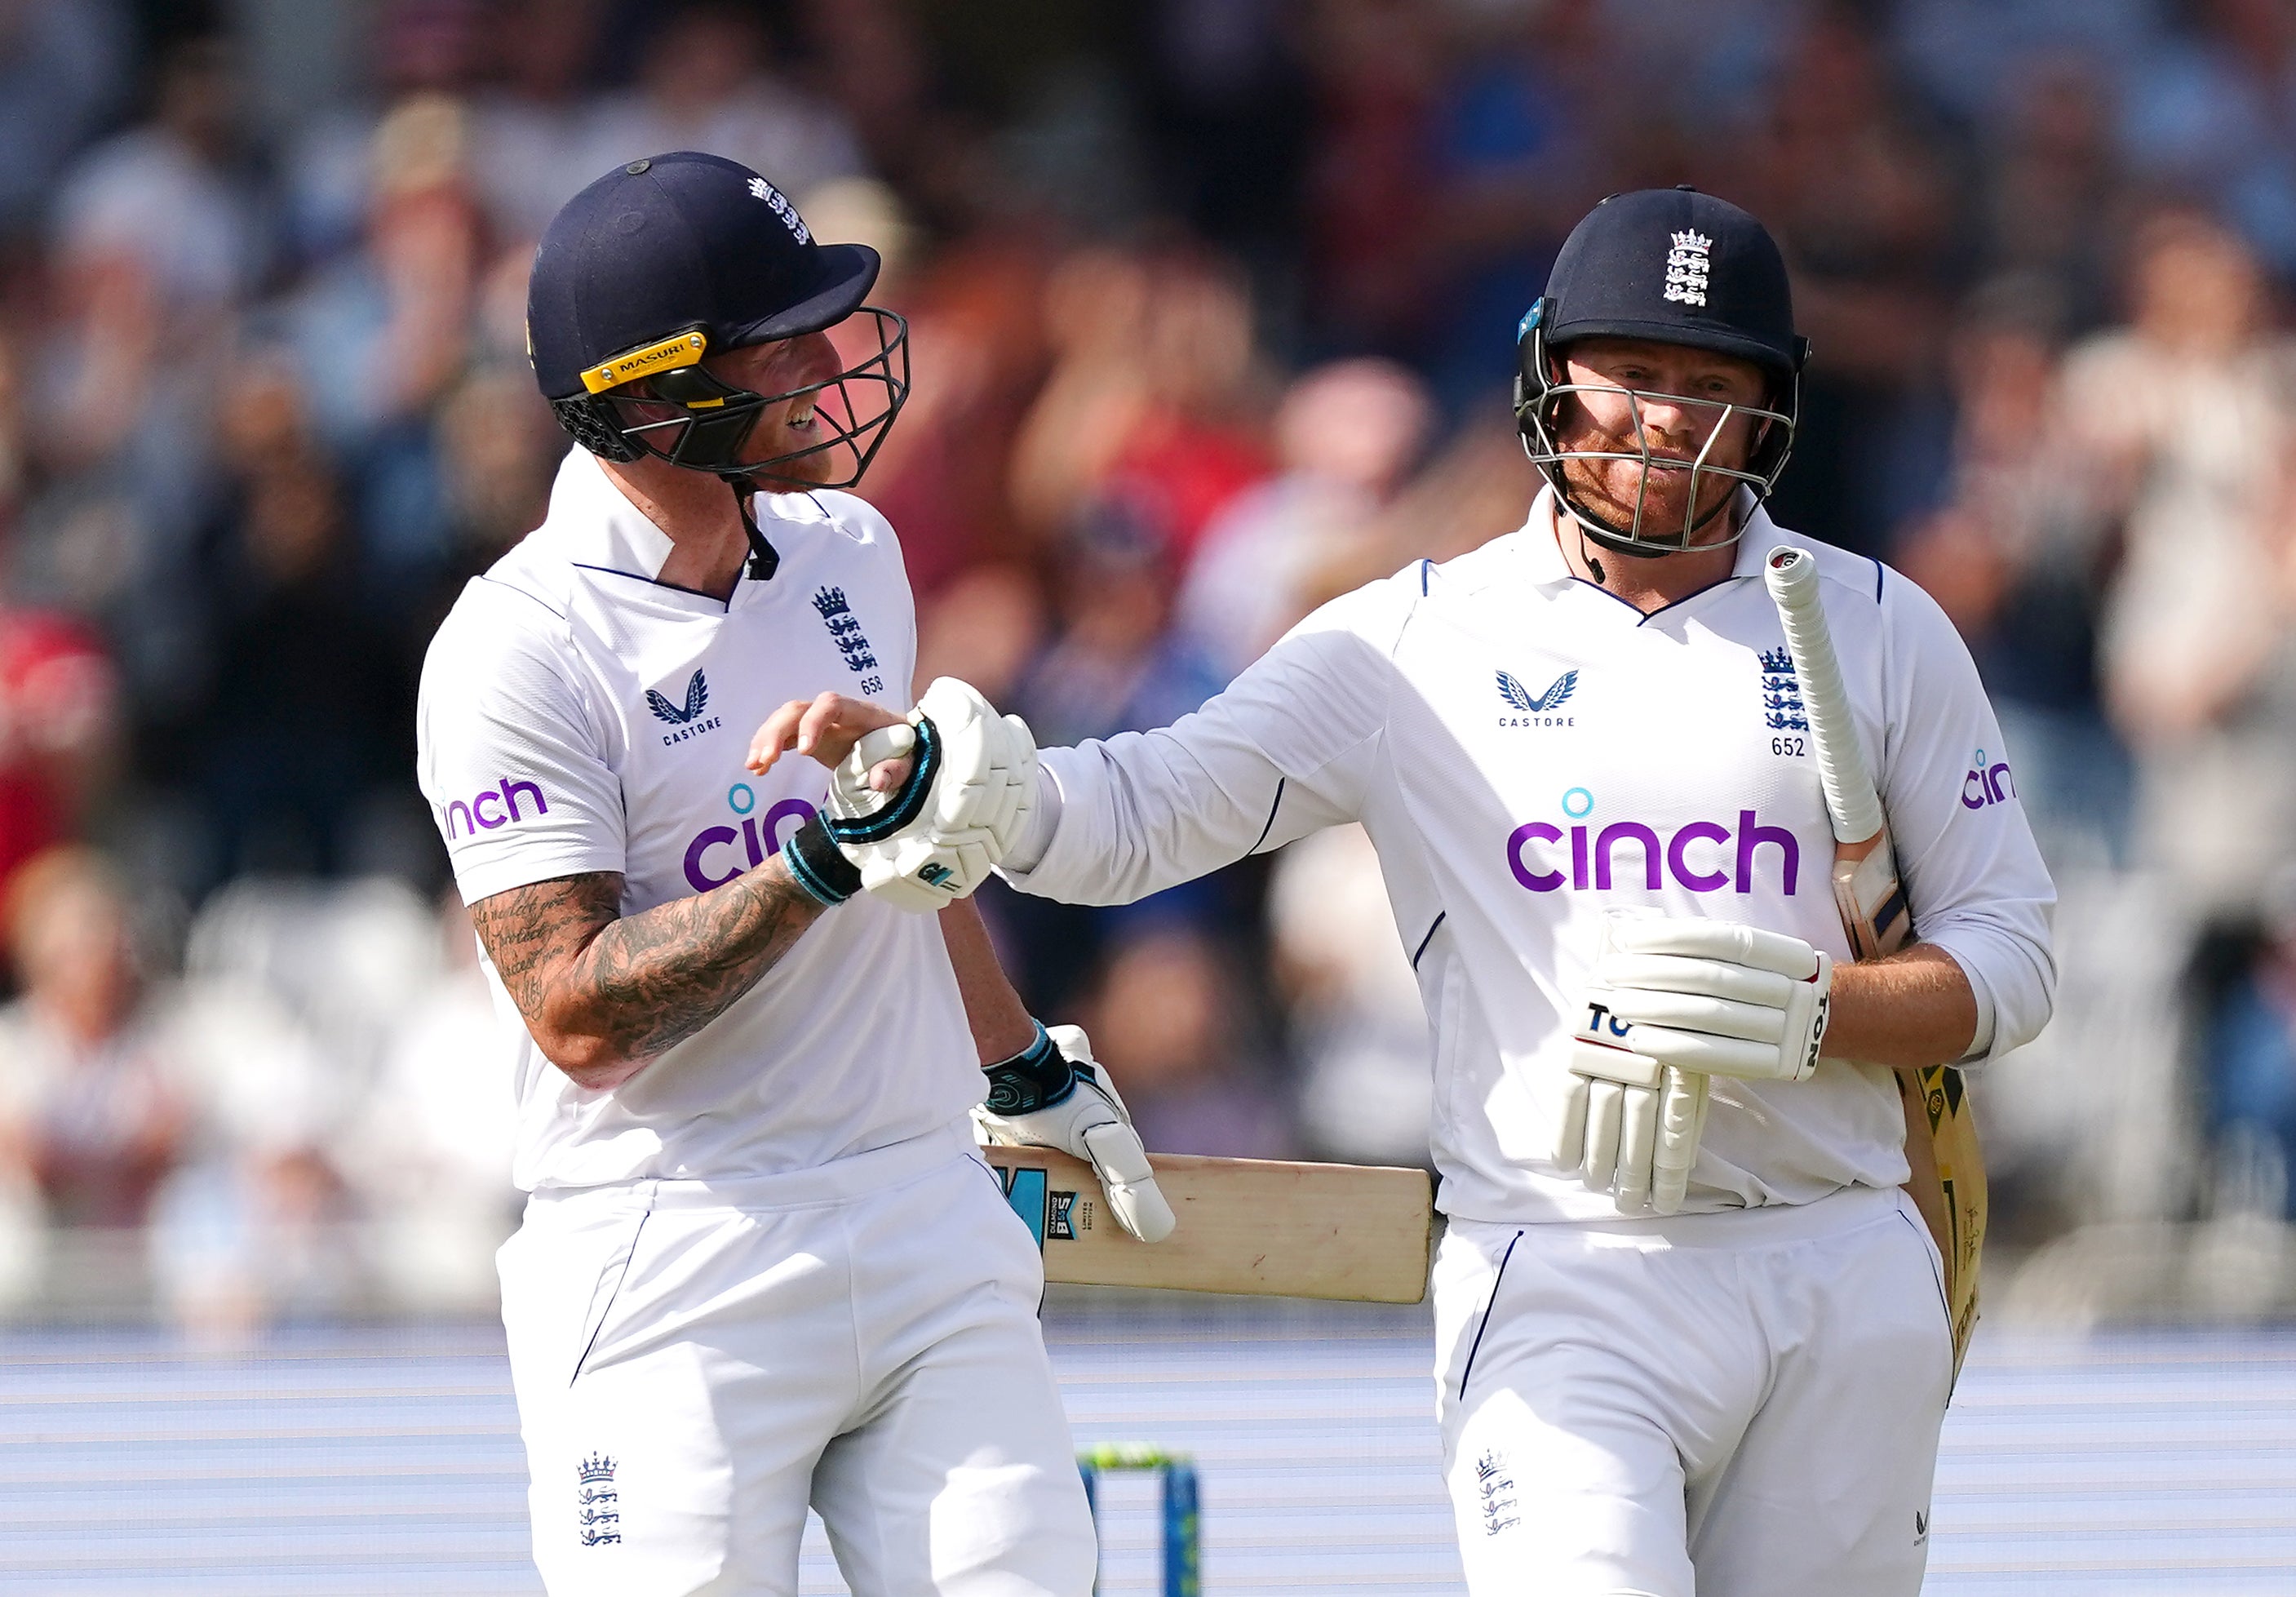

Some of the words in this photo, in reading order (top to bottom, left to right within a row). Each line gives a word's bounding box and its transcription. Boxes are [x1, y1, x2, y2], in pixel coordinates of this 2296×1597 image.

[619, 344, 685, 372] MASURI
[861, 676, 884, 695] 658
[663, 716, 721, 746] CASTORE
[1499, 717, 1575, 727] CASTORE
[1771, 738, 1805, 756] 652
[1507, 787, 1800, 896] cinch
[1807, 991, 1828, 1067] TON
